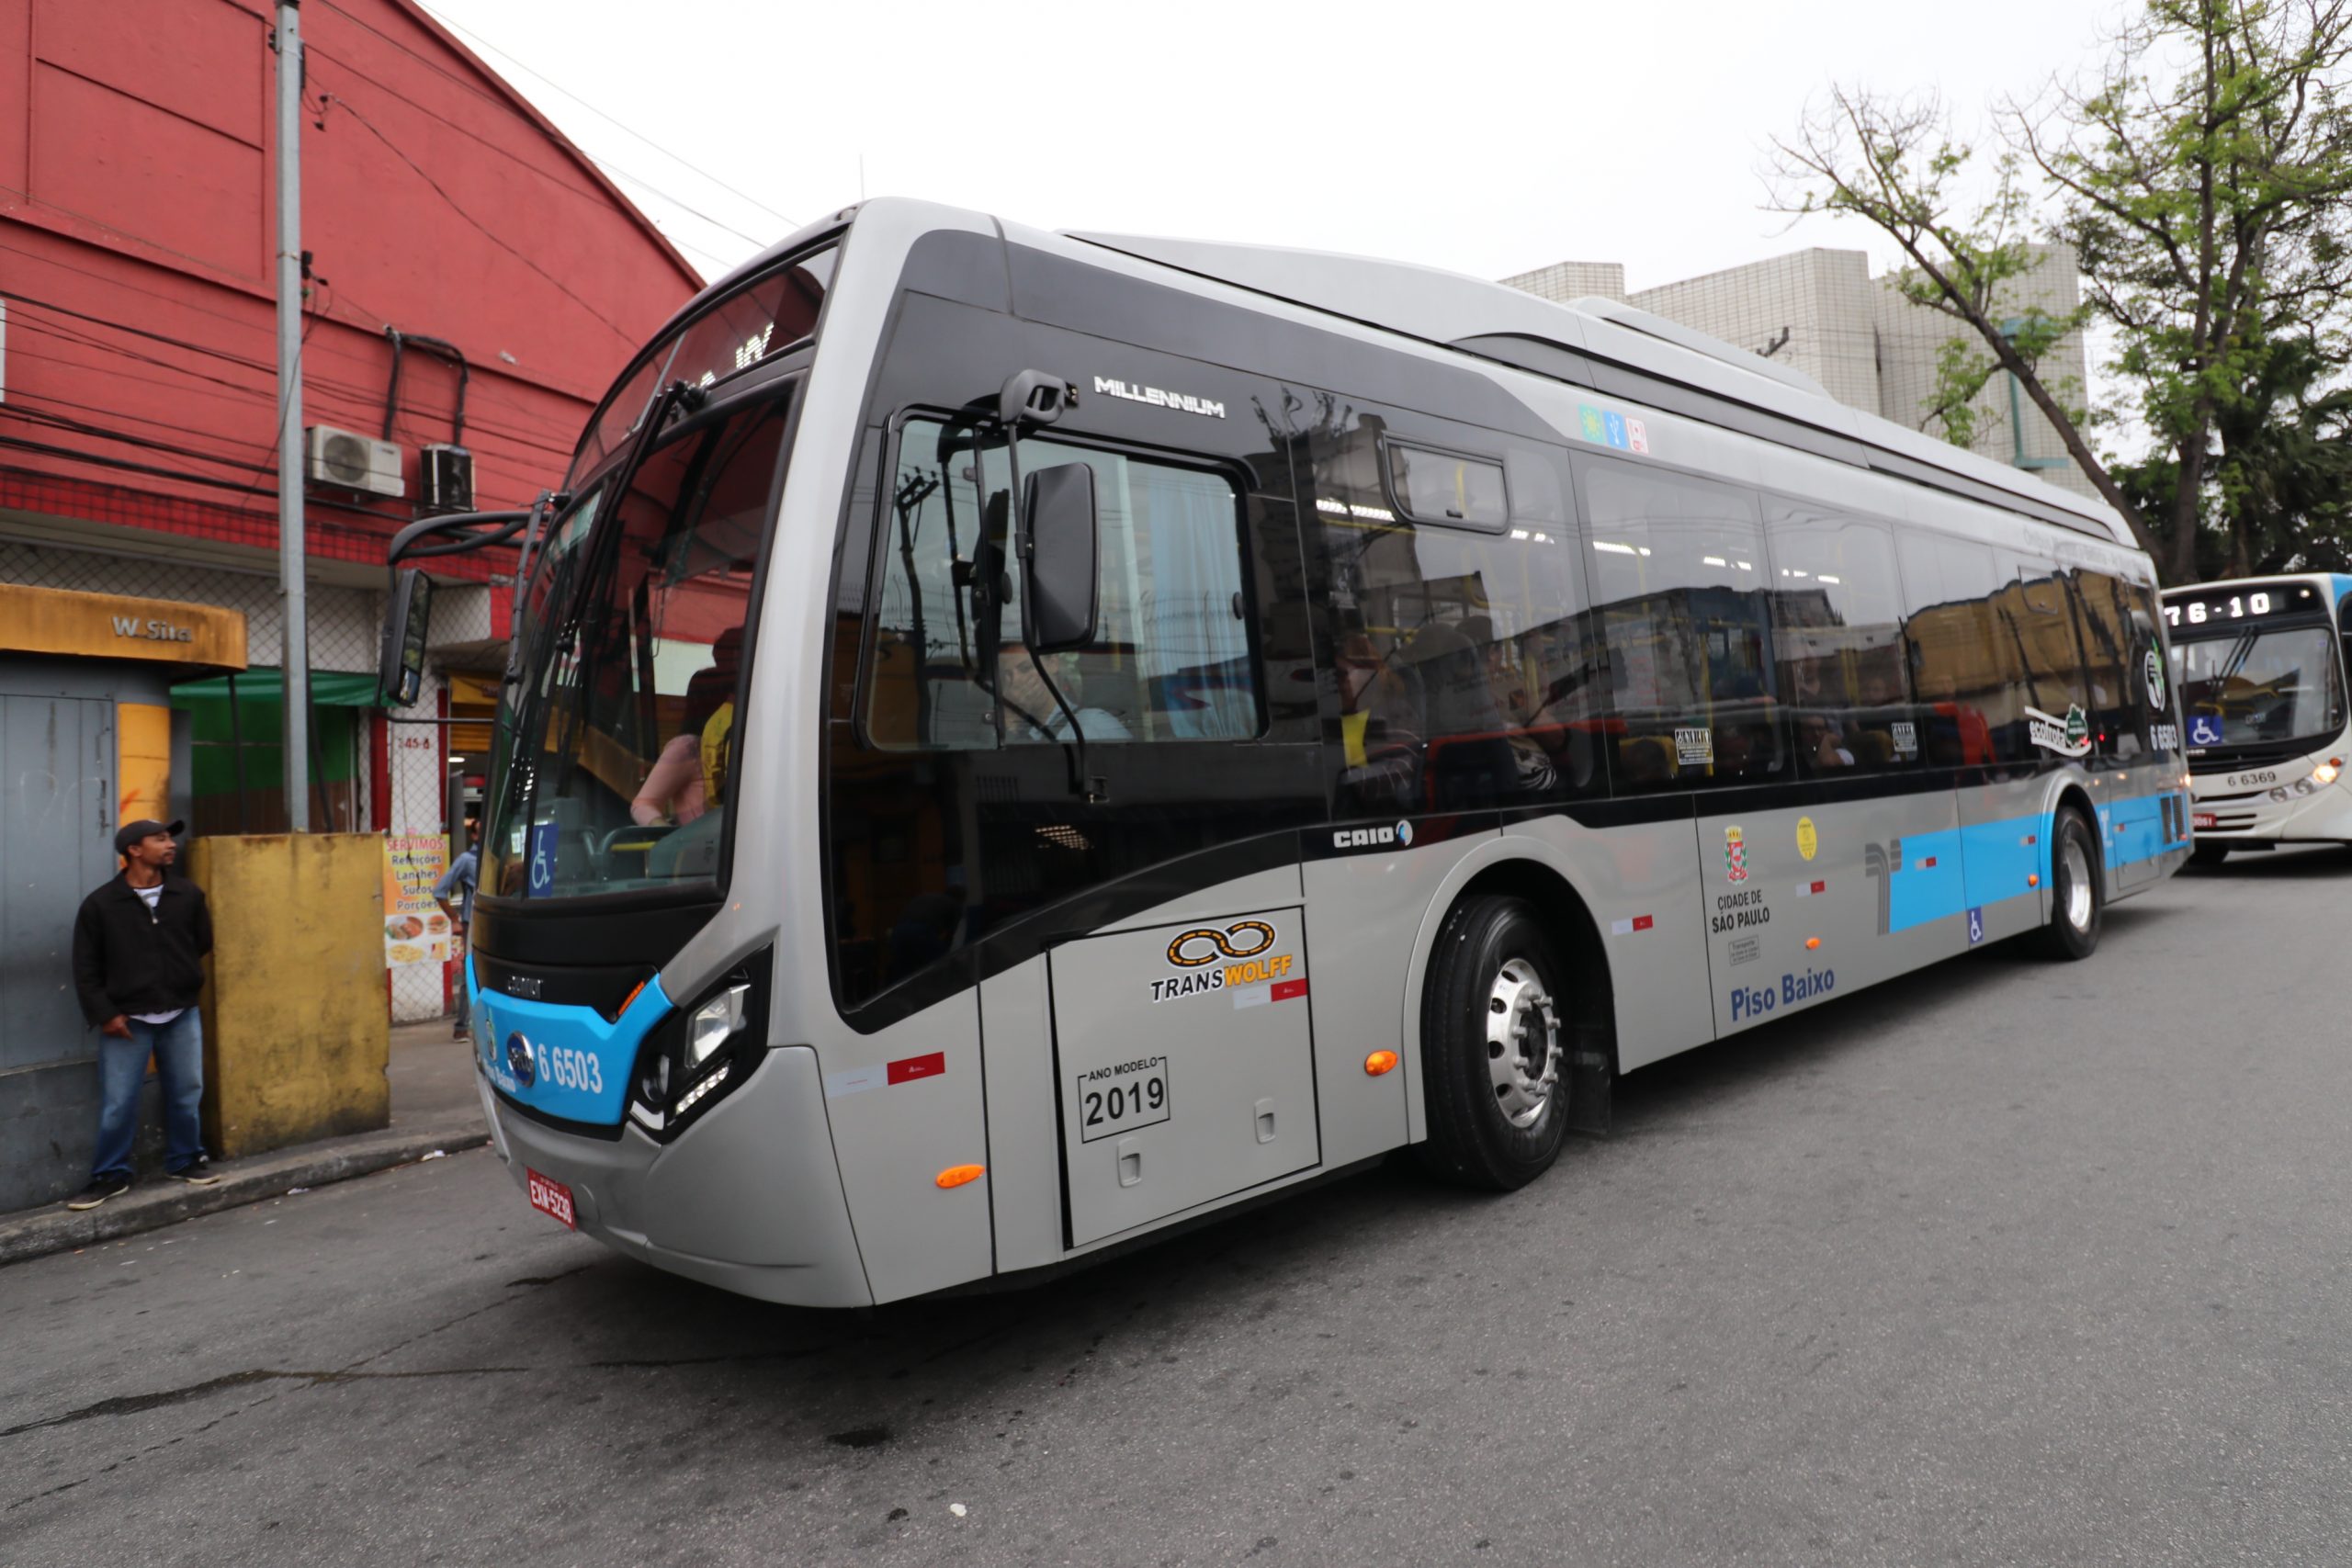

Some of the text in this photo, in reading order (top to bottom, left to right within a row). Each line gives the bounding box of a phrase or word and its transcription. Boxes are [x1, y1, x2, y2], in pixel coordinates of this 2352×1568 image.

[1093, 376, 1225, 418] MILLENNIUM
[2227, 771, 2277, 787] 6 6369
[1332, 826, 1395, 848] CAIO
[1717, 889, 1762, 910] CIDADE DE
[1712, 907, 1770, 933] SÃO PAULO
[1150, 953, 1293, 1002] TRANSWOLFF
[1730, 968, 1836, 1022] Piso Baixo
[537, 1043, 550, 1082] 6
[552, 1046, 604, 1094] 6503
[1088, 1056, 1158, 1082] ANO MODELO
[1085, 1077, 1165, 1127] 2019
